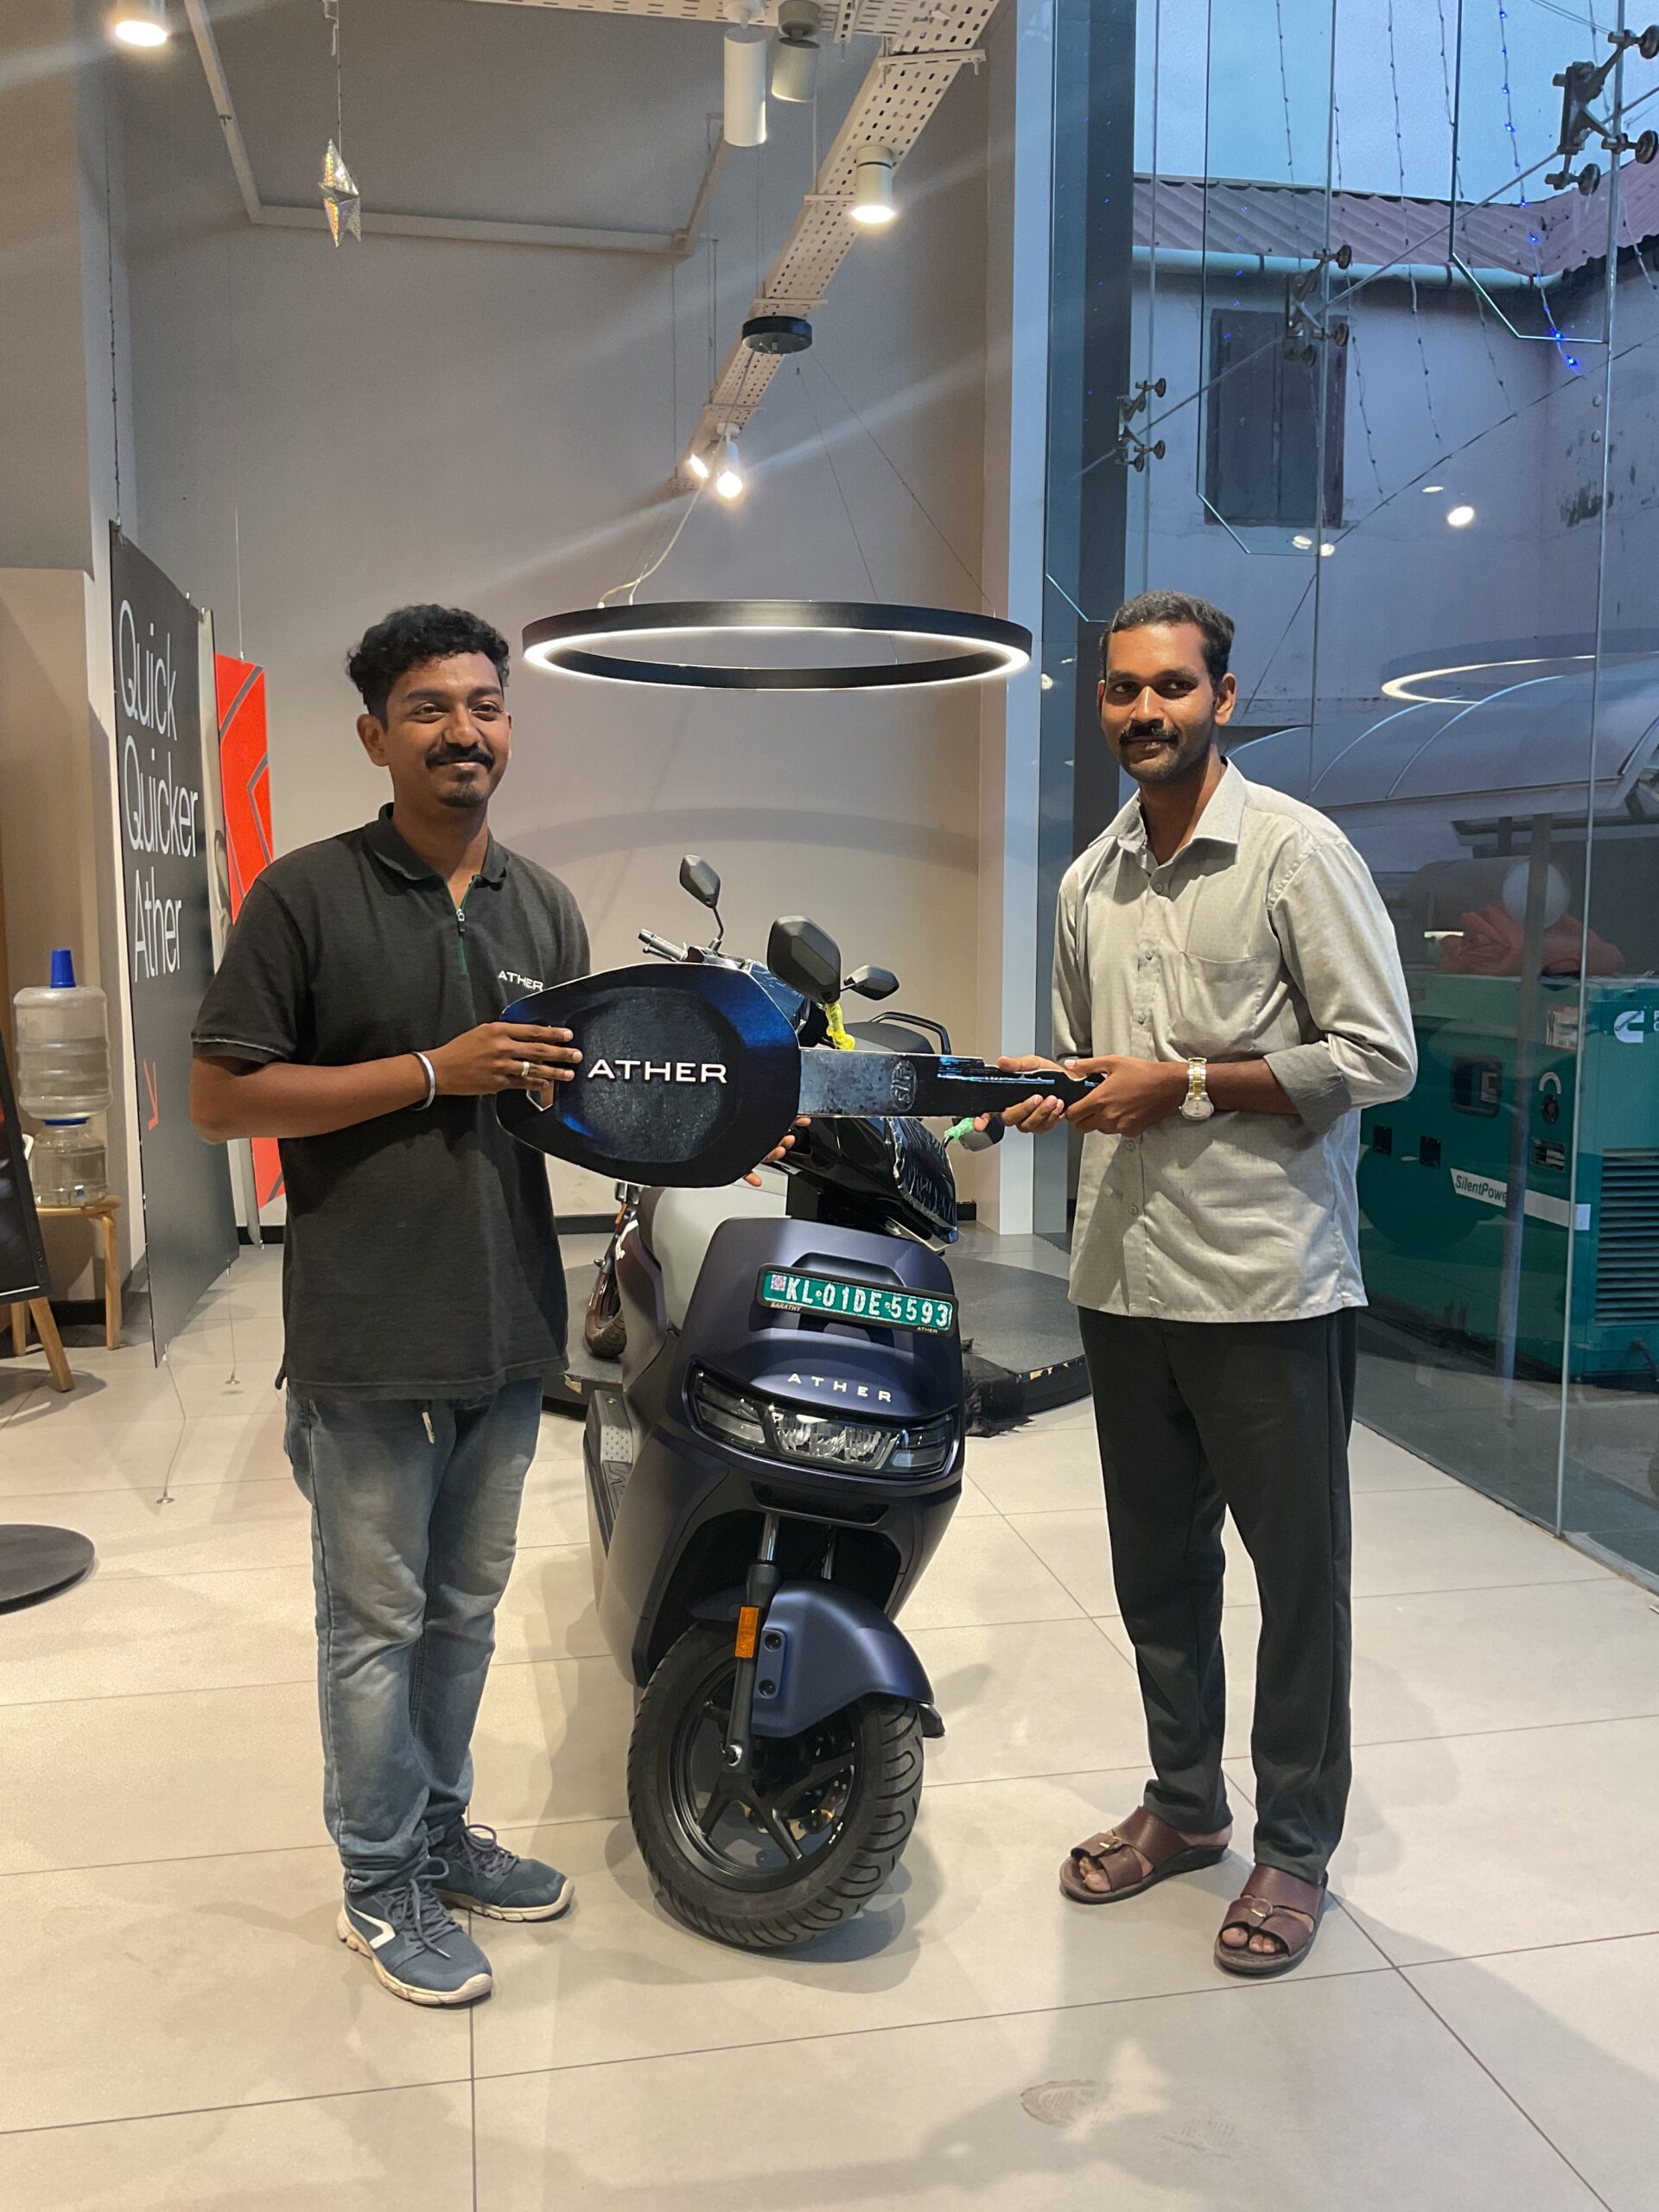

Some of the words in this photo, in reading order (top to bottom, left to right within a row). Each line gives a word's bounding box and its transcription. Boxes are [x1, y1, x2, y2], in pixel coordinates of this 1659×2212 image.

[118, 599, 178, 741] Quick
[123, 734, 198, 858] Quicker
[134, 866, 181, 982] Ather
[498, 969, 543, 992] ATHER
[588, 1058, 728, 1084] ATHER
[1455, 1174, 1508, 1203] SilentPowe
[787, 1372, 892, 1403] ATHER
